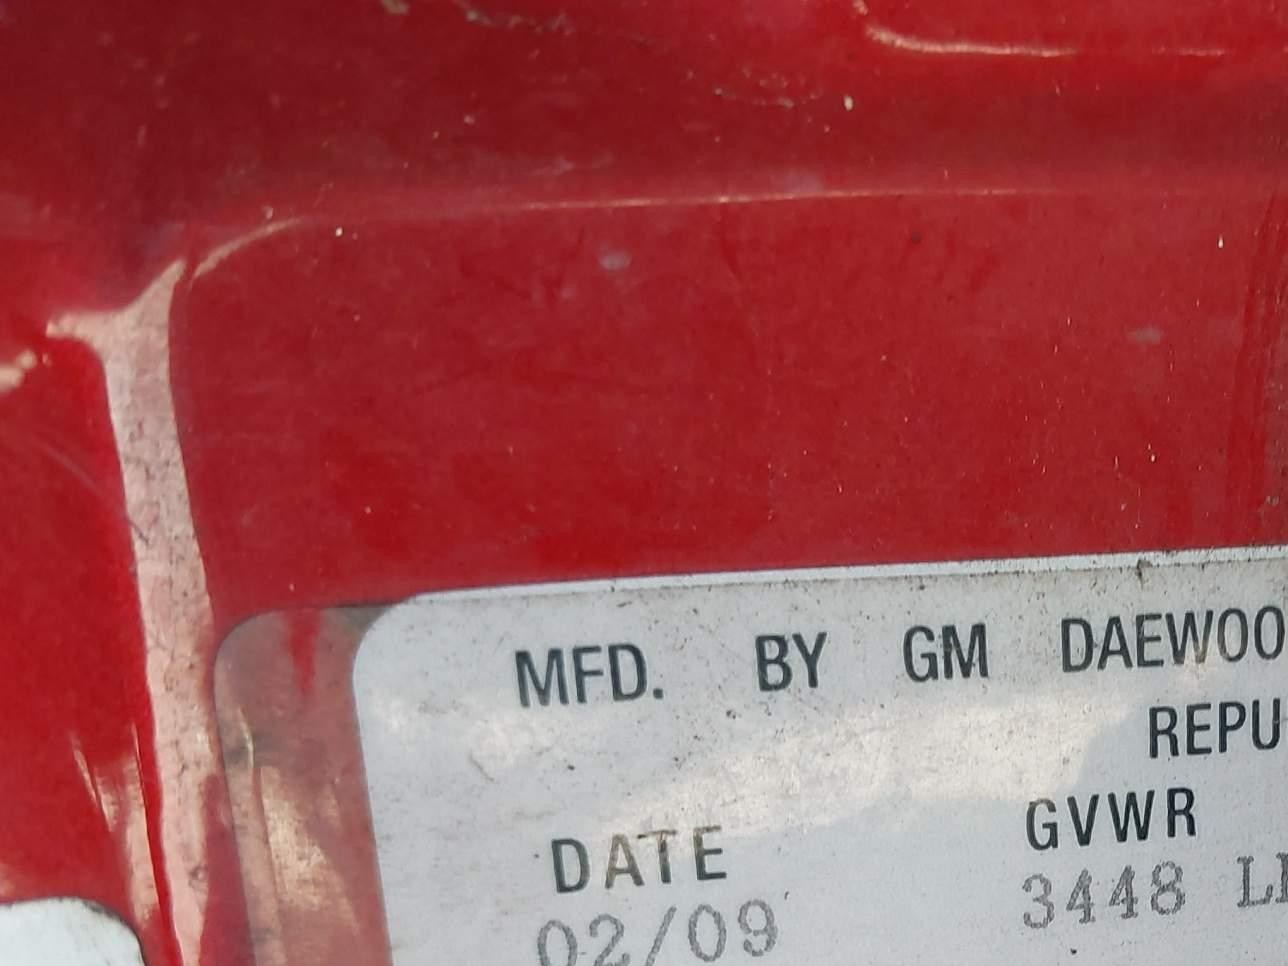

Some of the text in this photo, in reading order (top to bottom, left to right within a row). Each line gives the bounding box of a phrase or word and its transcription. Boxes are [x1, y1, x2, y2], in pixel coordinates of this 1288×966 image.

[515, 643, 664, 708] MFD.
[755, 632, 827, 692] BY
[903, 623, 990, 682] GM
[1061, 605, 1286, 673] DAEWOO
[1026, 787, 1196, 851] GVWR
[551, 825, 727, 893] DATE
[1022, 861, 1186, 929] 3448
